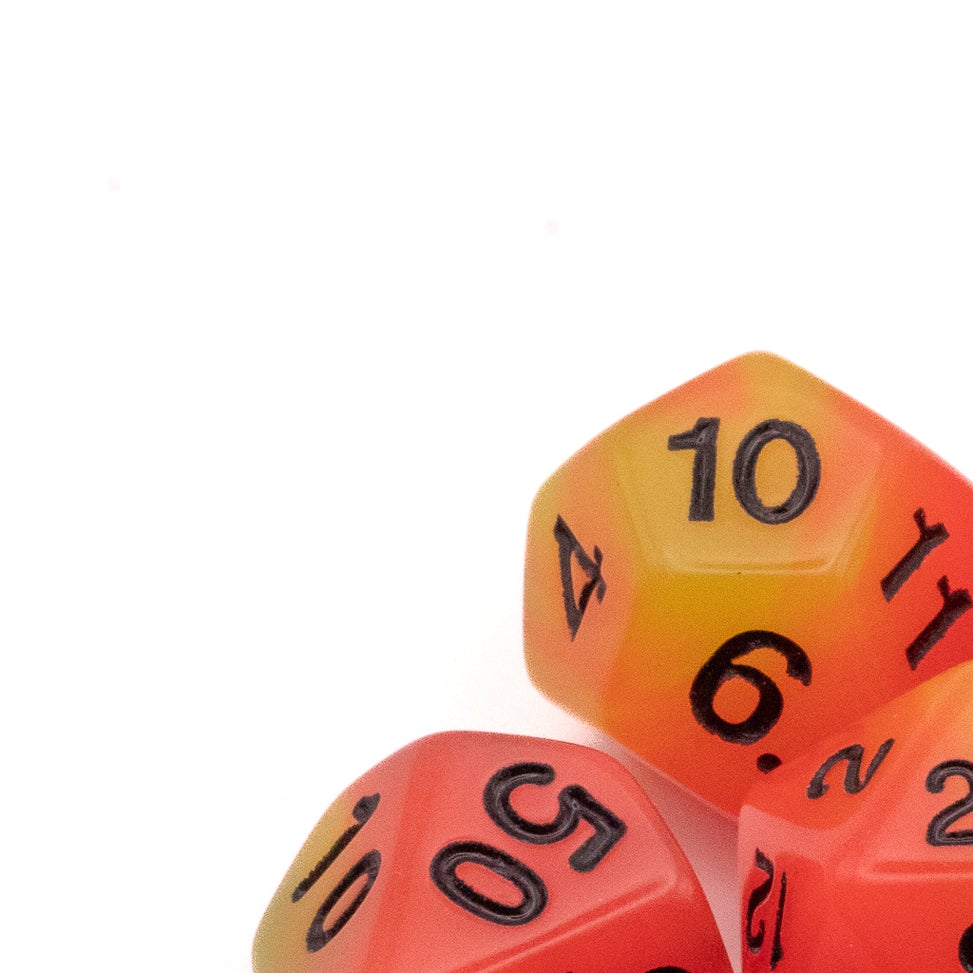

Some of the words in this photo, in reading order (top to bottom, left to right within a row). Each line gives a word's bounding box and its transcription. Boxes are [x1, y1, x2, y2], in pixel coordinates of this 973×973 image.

[668, 417, 822, 525] 10
[553, 514, 606, 642] 4
[881, 508, 973, 671] 11
[807, 738, 895, 799] 2
[291, 792, 382, 954] 10
[429, 761, 628, 927] 50
